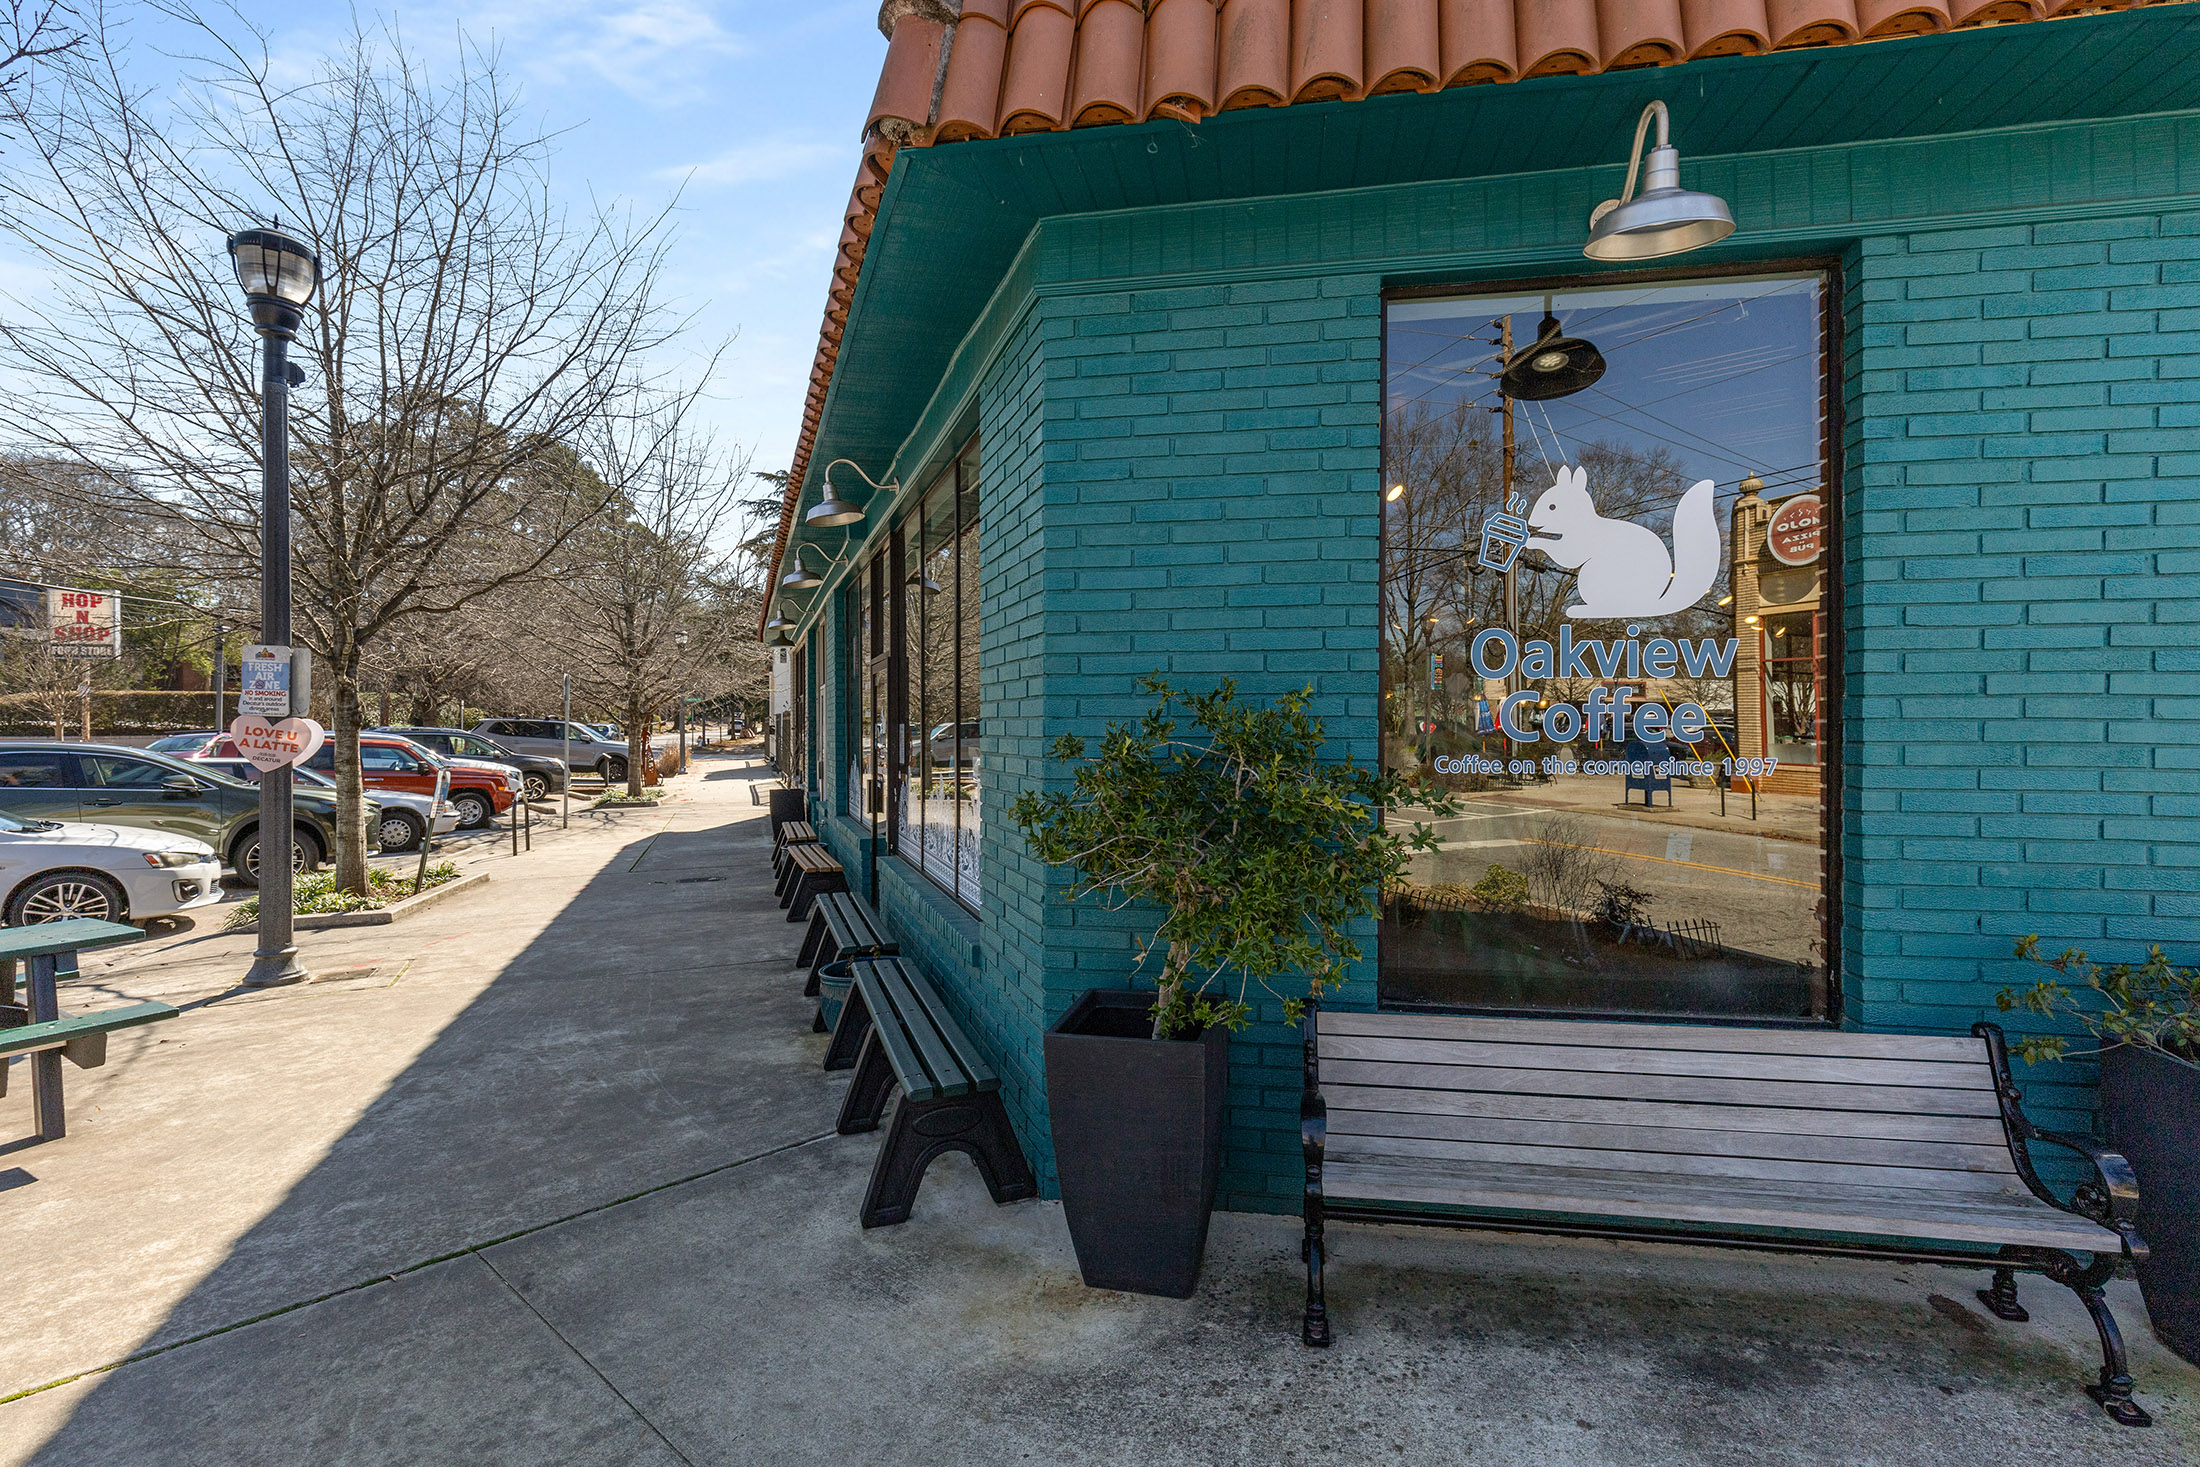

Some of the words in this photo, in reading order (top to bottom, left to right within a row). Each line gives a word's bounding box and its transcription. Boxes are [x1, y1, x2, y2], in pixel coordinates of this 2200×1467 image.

[61, 593, 103, 608] HOP
[76, 611, 89, 624] N
[54, 626, 110, 642] SHOP
[80, 645, 113, 656] STORE
[1471, 624, 1740, 680] Oakview
[248, 662, 283, 672] FRESH
[255, 671, 275, 681] AIR
[1499, 687, 1707, 743] Coffee
[244, 725, 284, 740] LOVE
[287, 730, 298, 741] U
[239, 737, 250, 748] A
[253, 739, 299, 753] LATTE
[252, 755, 281, 763] DECATUR
[1434, 754, 1503, 774] Coffee
[1508, 759, 1536, 774] on
[1542, 755, 1577, 774] the
[1583, 759, 1654, 775] corner
[1658, 756, 1714, 776] since
[1722, 756, 1778, 777] 1997
